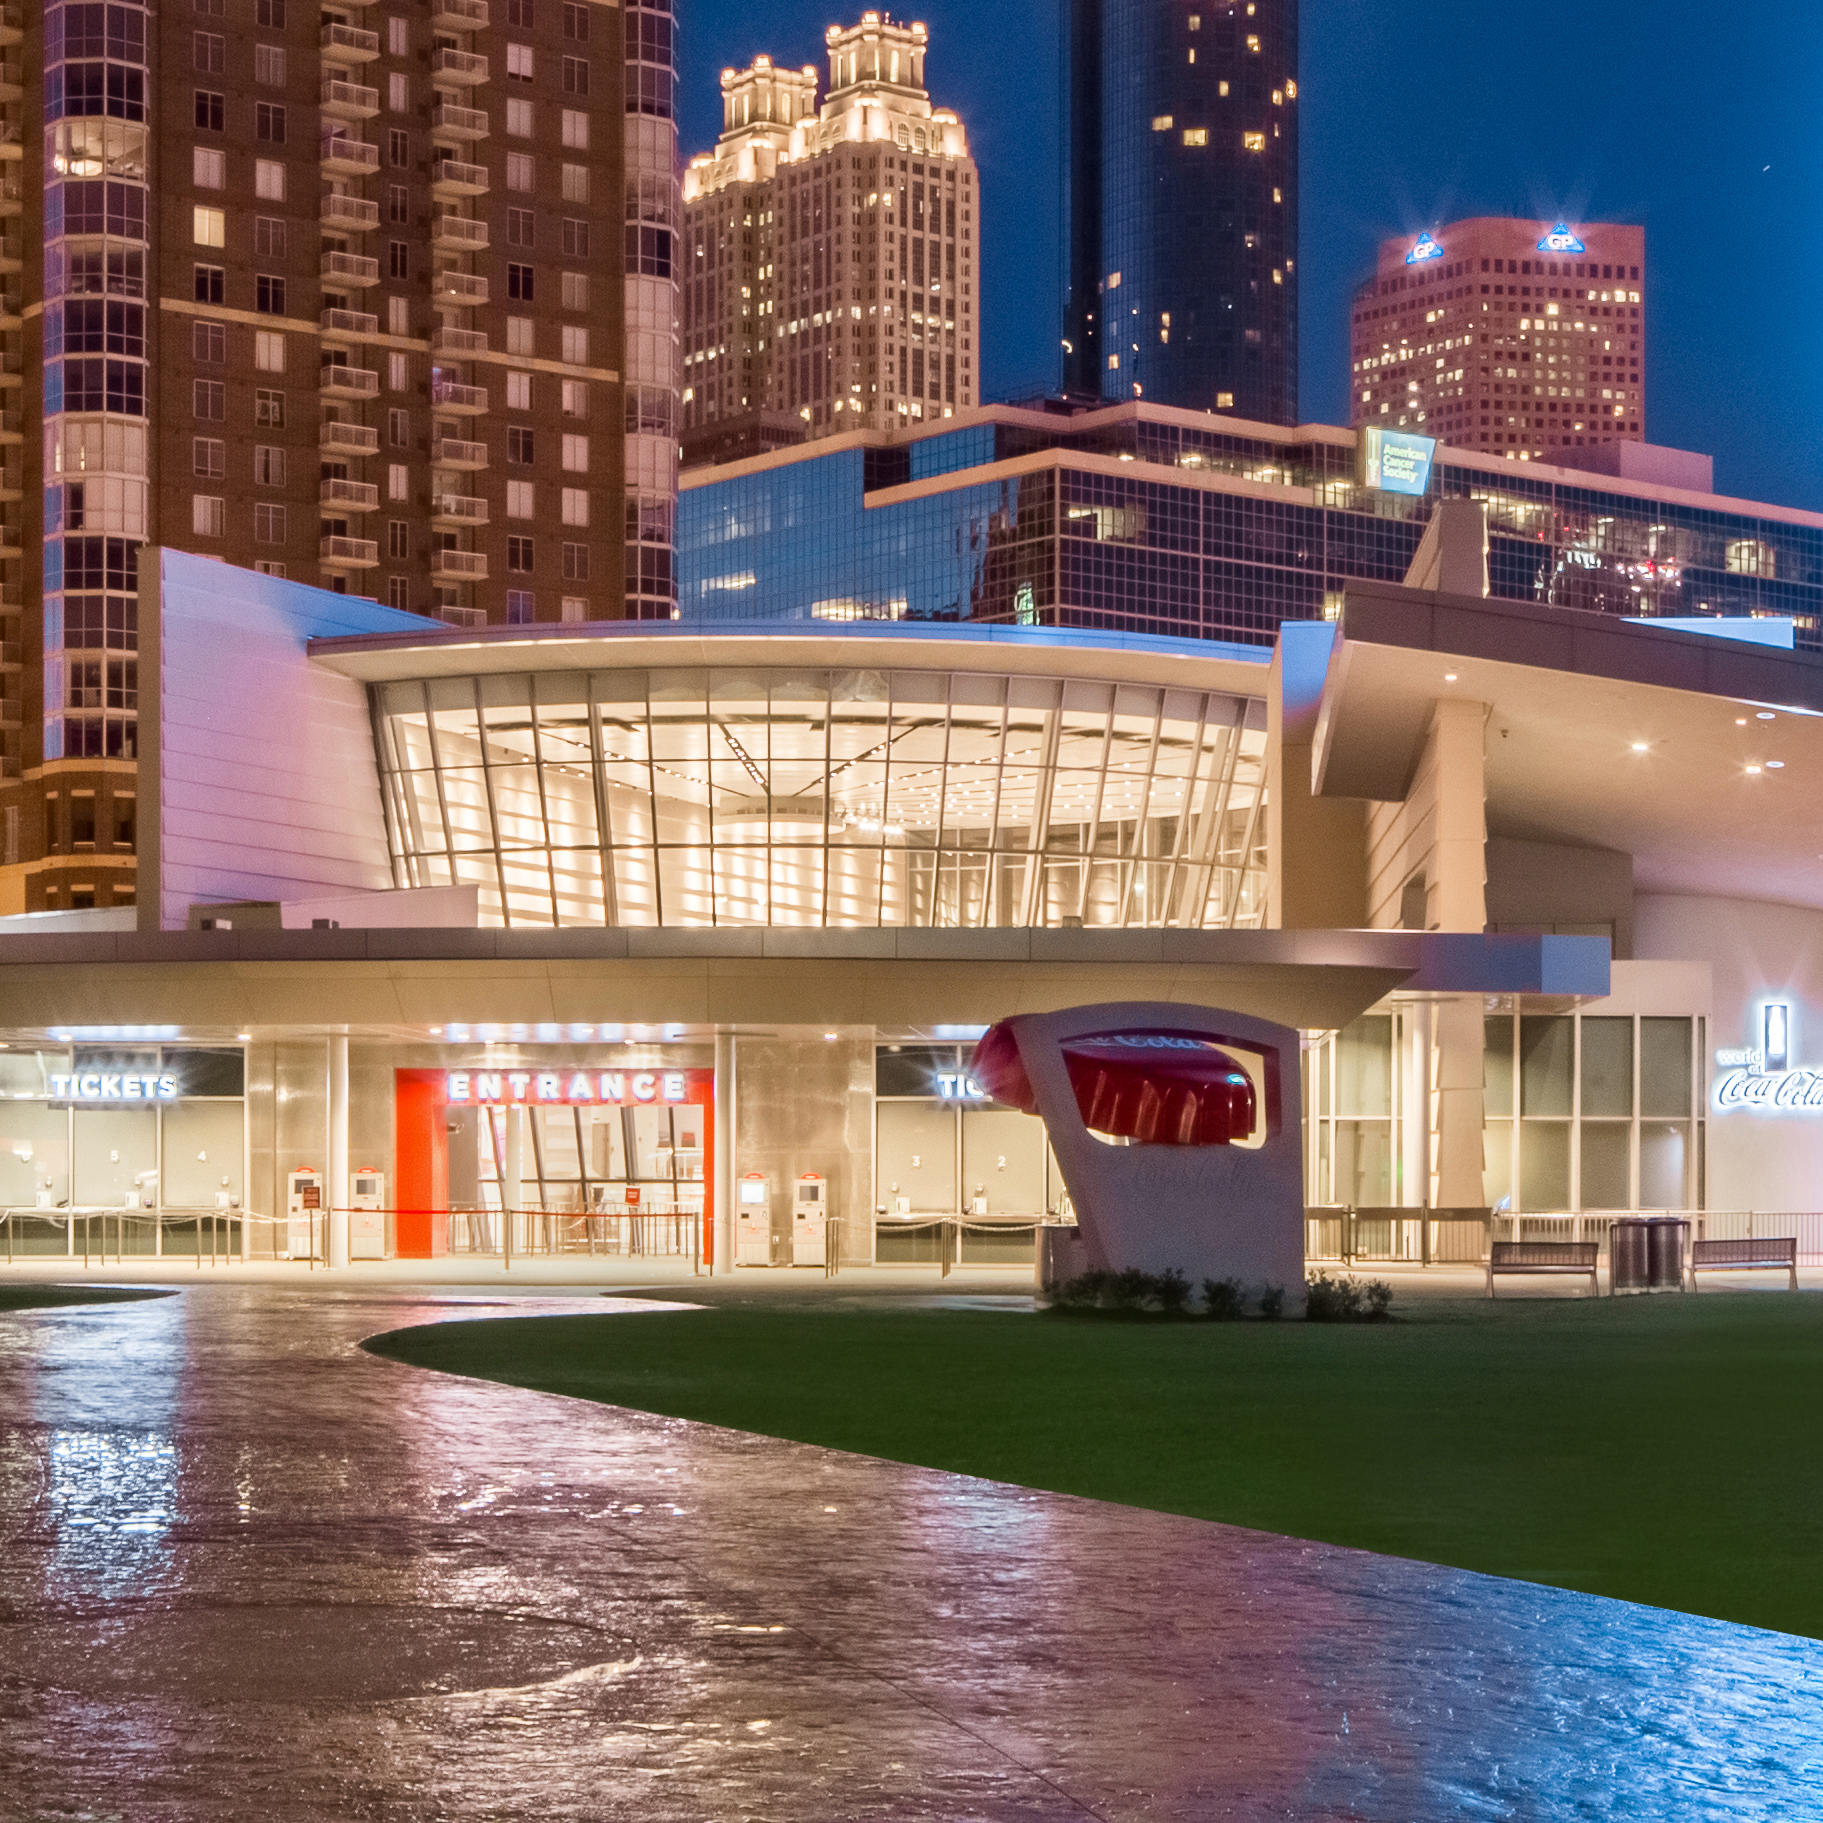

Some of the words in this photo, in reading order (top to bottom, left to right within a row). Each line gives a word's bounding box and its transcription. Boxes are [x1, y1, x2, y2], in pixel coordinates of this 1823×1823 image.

[1547, 234, 1574, 249] GP
[1413, 241, 1435, 259] GP
[1720, 1047, 1762, 1064] world
[51, 1075, 177, 1098] TICKETS
[448, 1074, 686, 1100] ENTRANCE
[110, 1150, 120, 1163] 5
[197, 1151, 207, 1163] 4
[912, 1155, 921, 1167] 3
[997, 1155, 1006, 1167] 2
